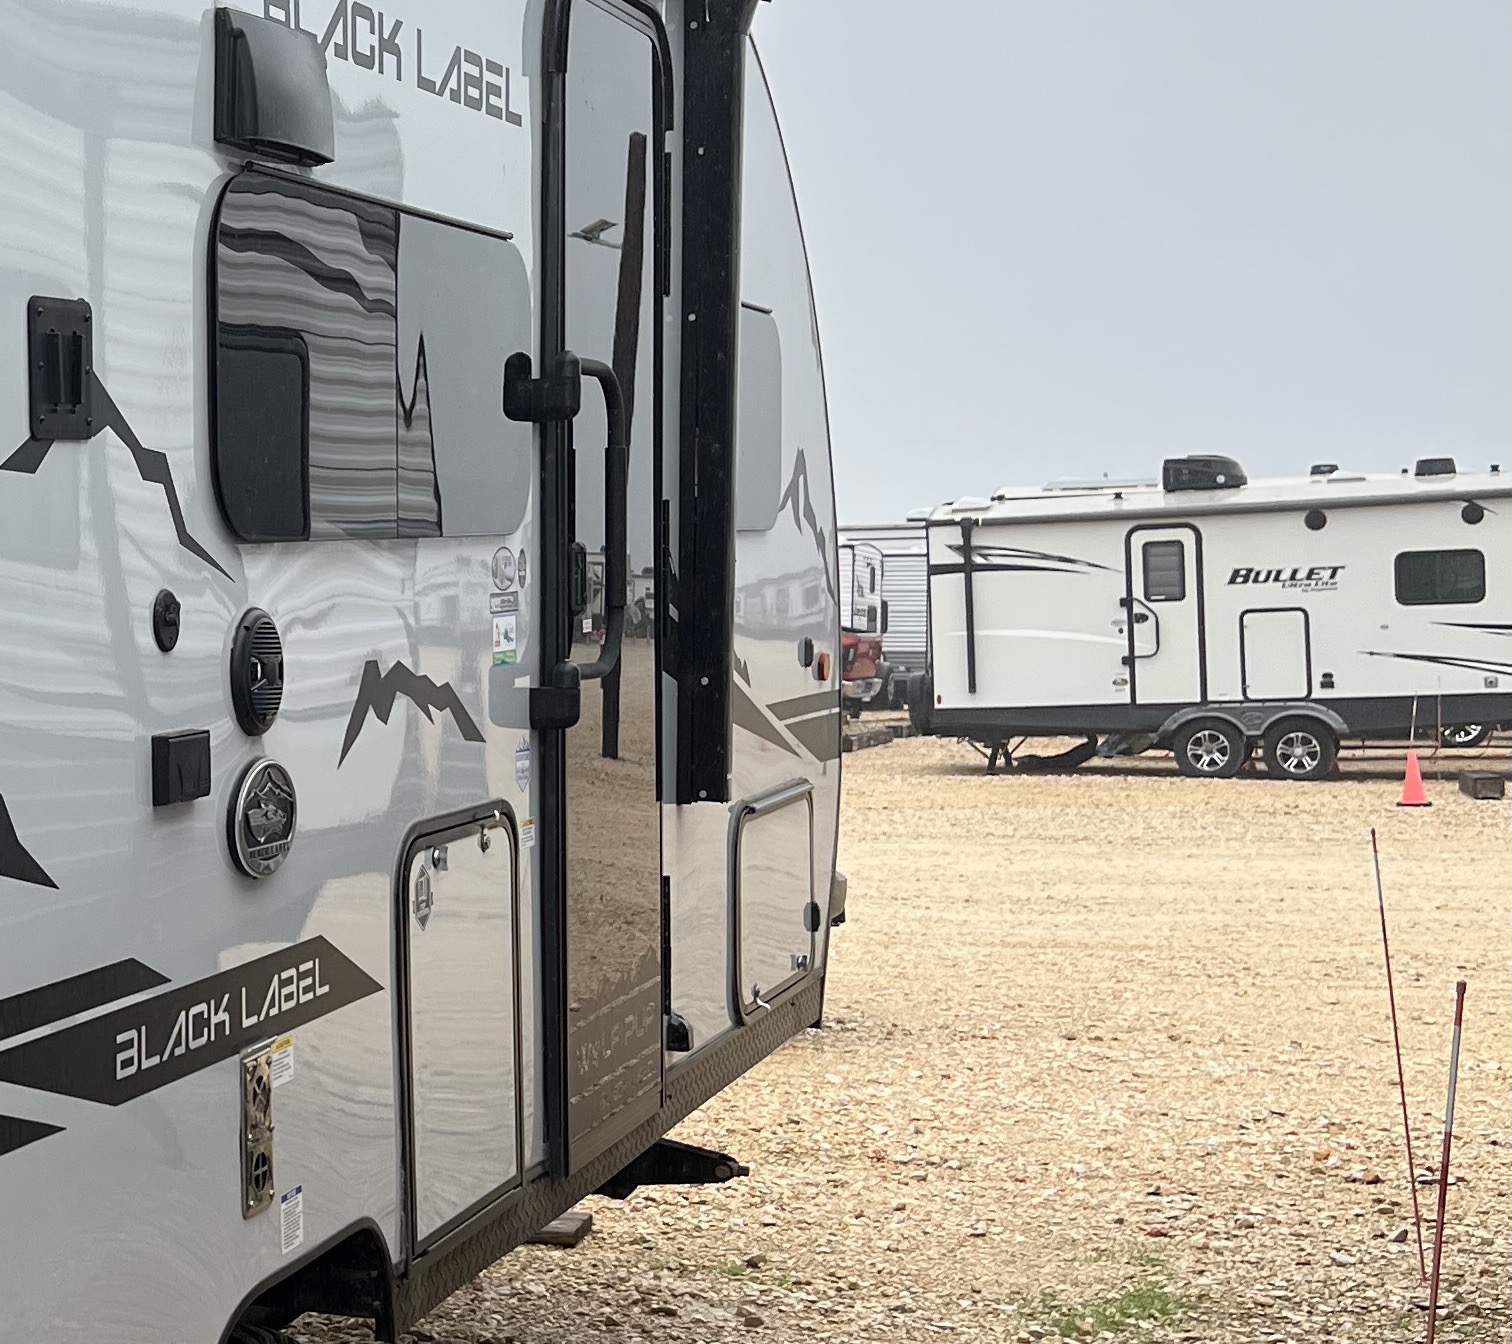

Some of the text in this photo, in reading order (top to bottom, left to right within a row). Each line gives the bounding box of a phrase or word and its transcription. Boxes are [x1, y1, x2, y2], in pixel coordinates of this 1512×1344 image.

[416, 27, 523, 128] LABEL
[1227, 565, 1346, 586] BULLET
[115, 992, 231, 1081] BLACK
[241, 957, 330, 1029] LABEL
